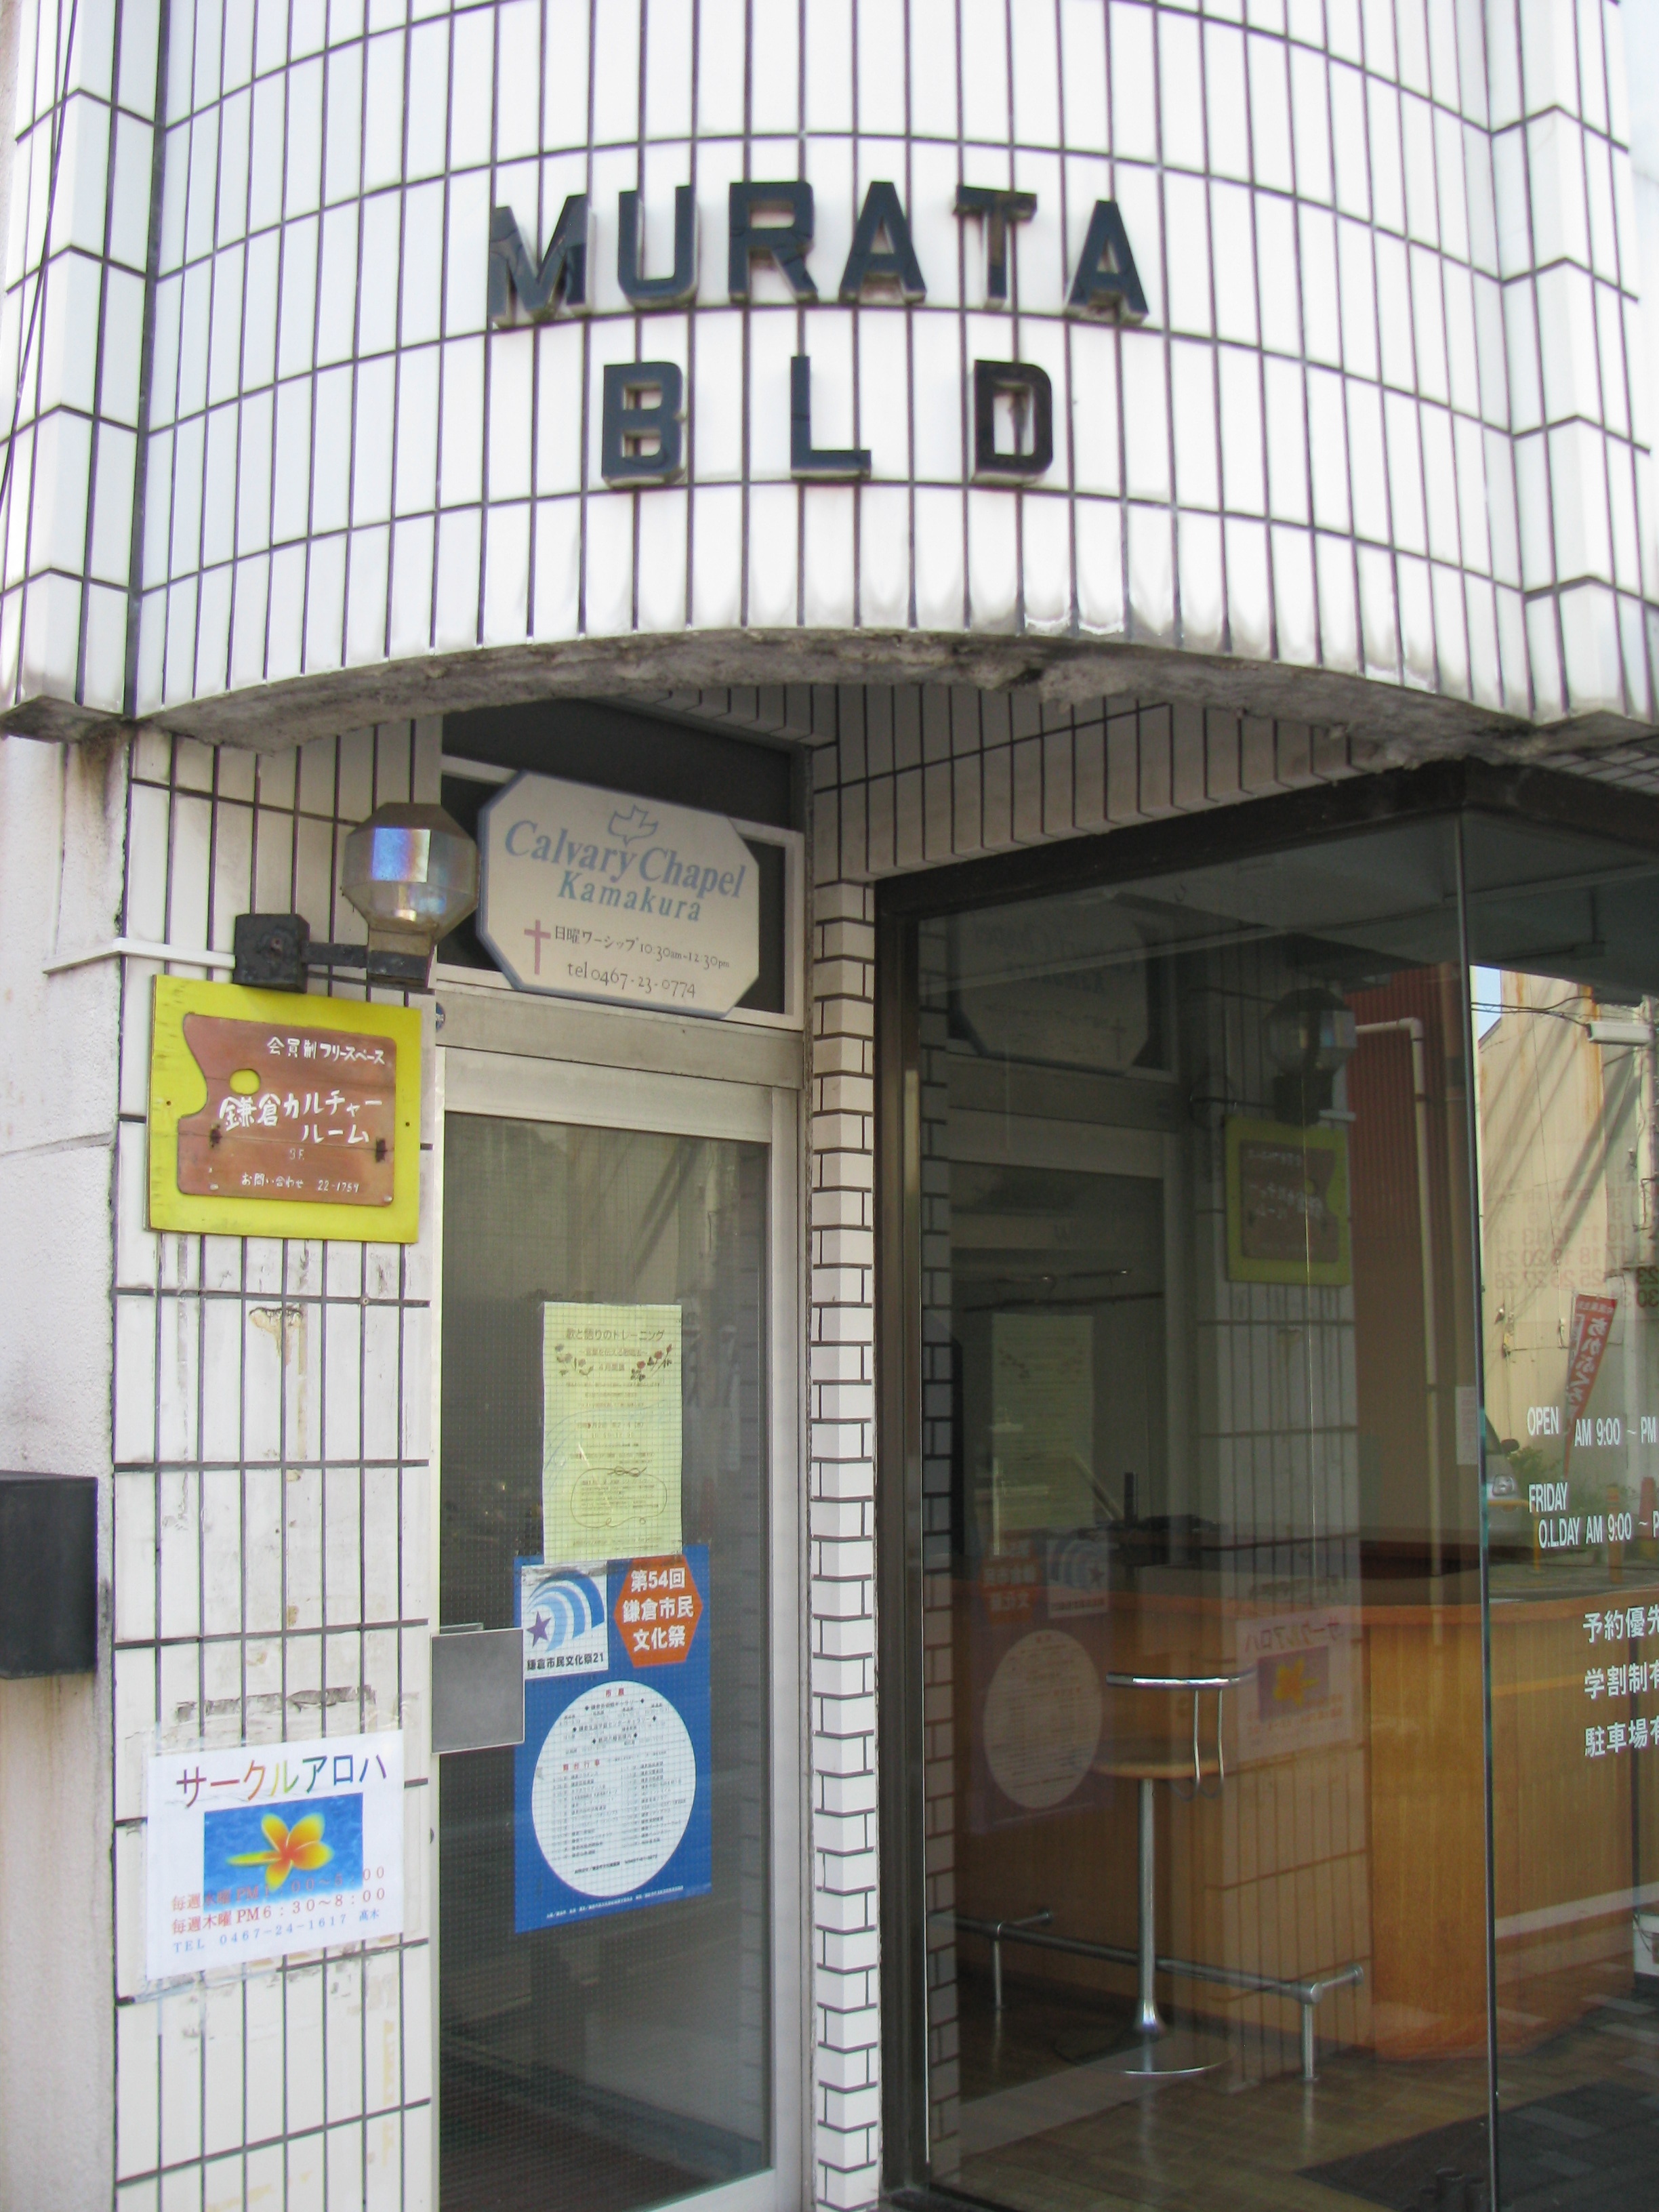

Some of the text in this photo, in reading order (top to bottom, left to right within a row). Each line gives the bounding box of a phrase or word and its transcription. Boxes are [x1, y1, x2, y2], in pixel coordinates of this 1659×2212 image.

[488, 181, 1149, 328] MURATA
[601, 355, 1053, 486] BLD
[504, 819, 746, 899] Calvary Chapel
[557, 870, 701, 922] Kamakura
[567, 961, 588, 979] tel
[219, 1089, 383, 1131] 鎌倉カルチャー
[301, 1124, 369, 1144] ルーム
[241, 1172, 304, 1189] お問い合わせ
[1527, 1406, 1559, 1436] OPEN
[1574, 1418, 1591, 1447] AM
[1596, 1418, 1620, 1446] 9:00
[1641, 1416, 1656, 1443] PM
[1529, 1482, 1568, 1513] FRIDAY
[1586, 1515, 1603, 1544] AM
[1608, 1513, 1632, 1542] 9:00
[630, 1567, 686, 1593] 第54回
[622, 1595, 694, 1624] 鎌倉市民
[632, 1625, 686, 1652] 文化祭
[176, 1754, 388, 1809] サークルアロハ
[173, 1940, 205, 1954] TEL
